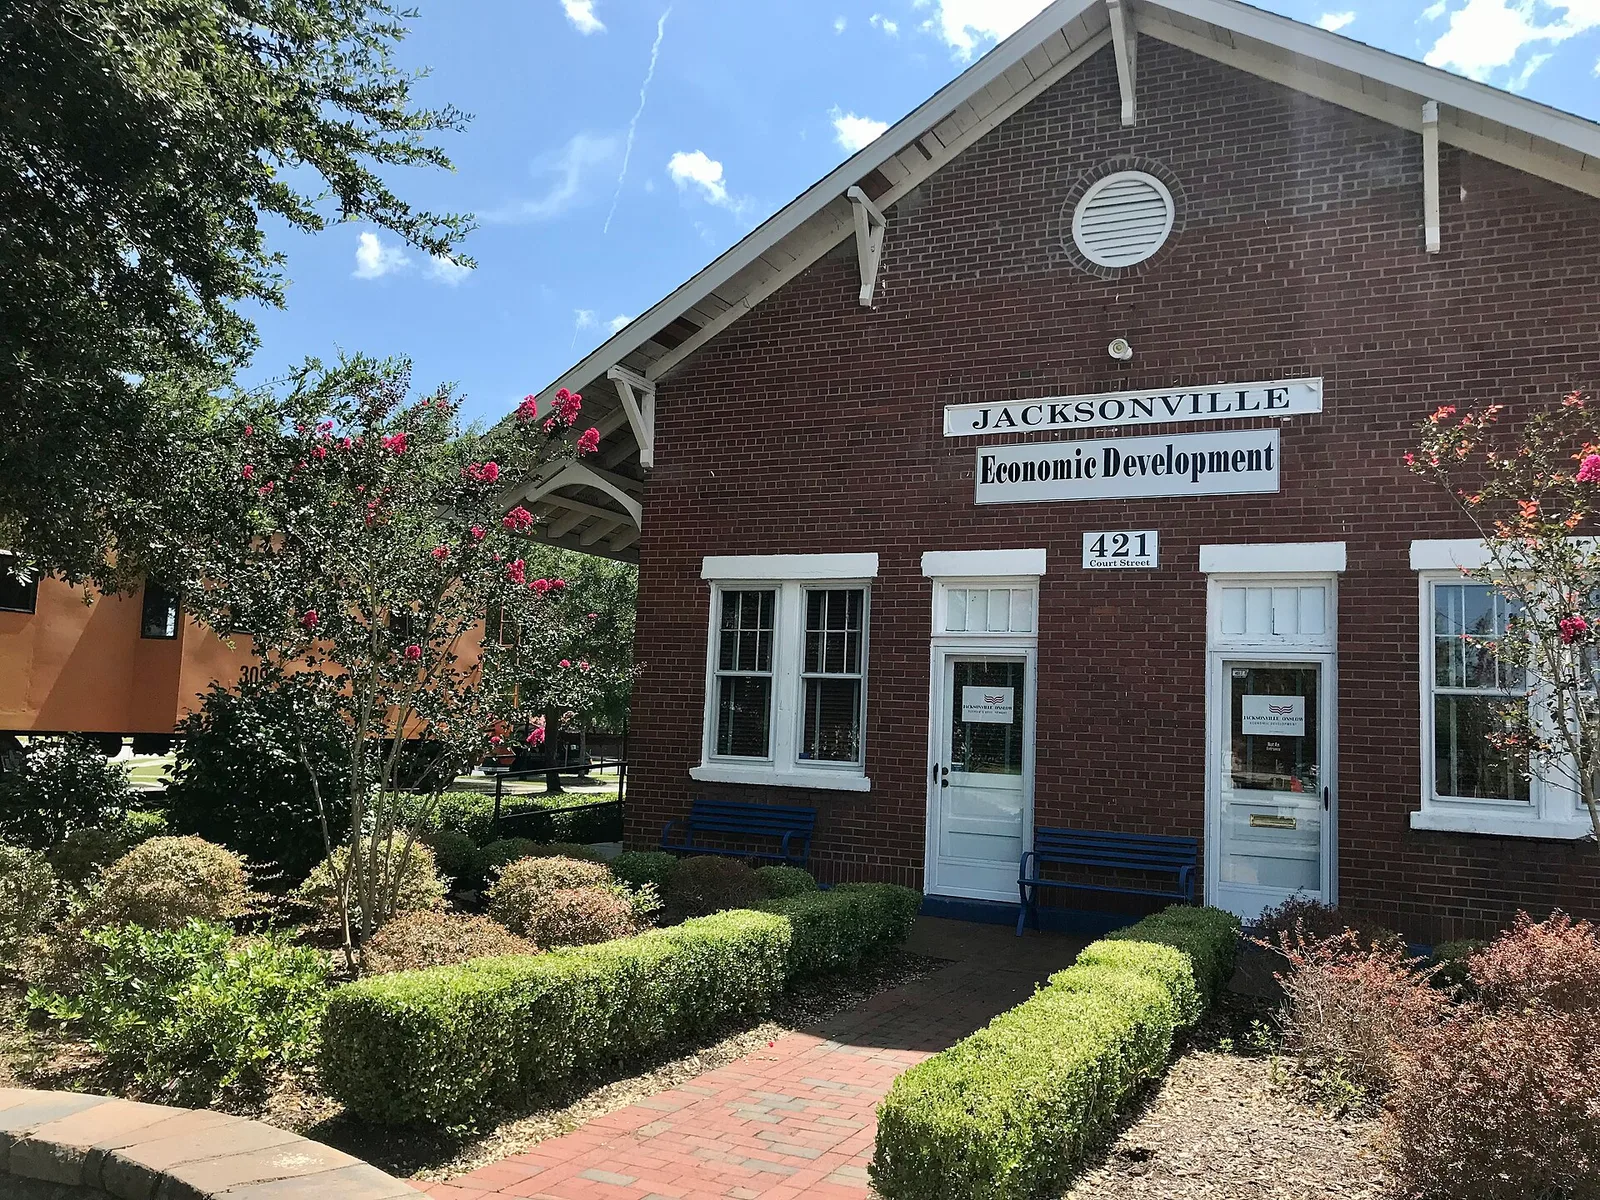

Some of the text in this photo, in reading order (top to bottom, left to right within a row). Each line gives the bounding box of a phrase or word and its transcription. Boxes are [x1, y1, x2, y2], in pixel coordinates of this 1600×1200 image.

[972, 387, 1290, 430] JACKSONVILLE
[980, 441, 1274, 485] Economic Development
[1089, 533, 1151, 558] 421
[1120, 559, 1150, 567] Street
